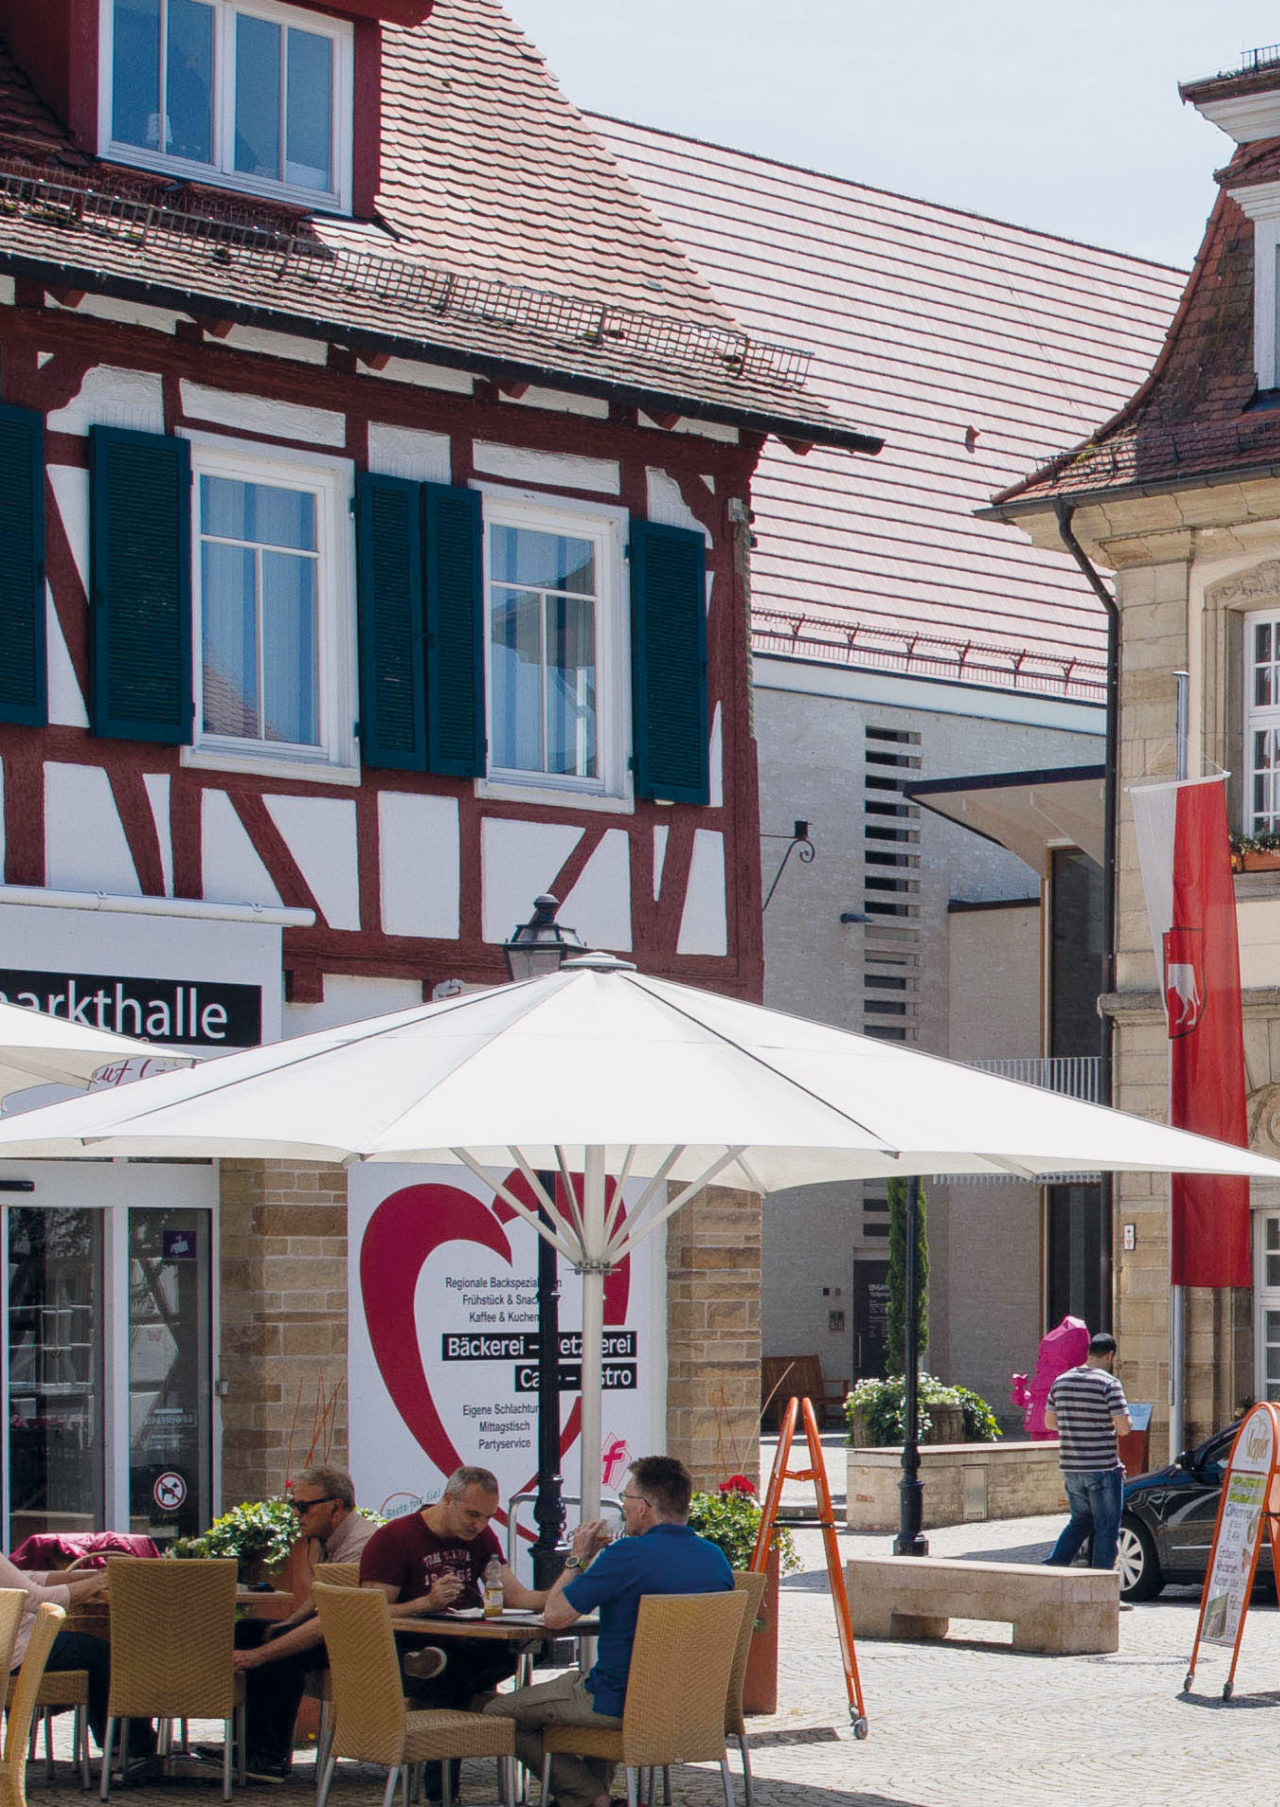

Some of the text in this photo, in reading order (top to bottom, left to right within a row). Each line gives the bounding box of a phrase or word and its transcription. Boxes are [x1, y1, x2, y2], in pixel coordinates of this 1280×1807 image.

[446, 1277, 488, 1290] Regionale
[462, 1294, 505, 1305] Frühstück
[506, 1295, 514, 1305] &
[469, 1312, 497, 1323] Kaffee
[499, 1312, 506, 1323] &
[448, 1336, 525, 1356] Bäckerei
[463, 1404, 492, 1418] Eigene
[479, 1420, 531, 1434] Mittagstisch
[479, 1438, 531, 1452] Partyservice
